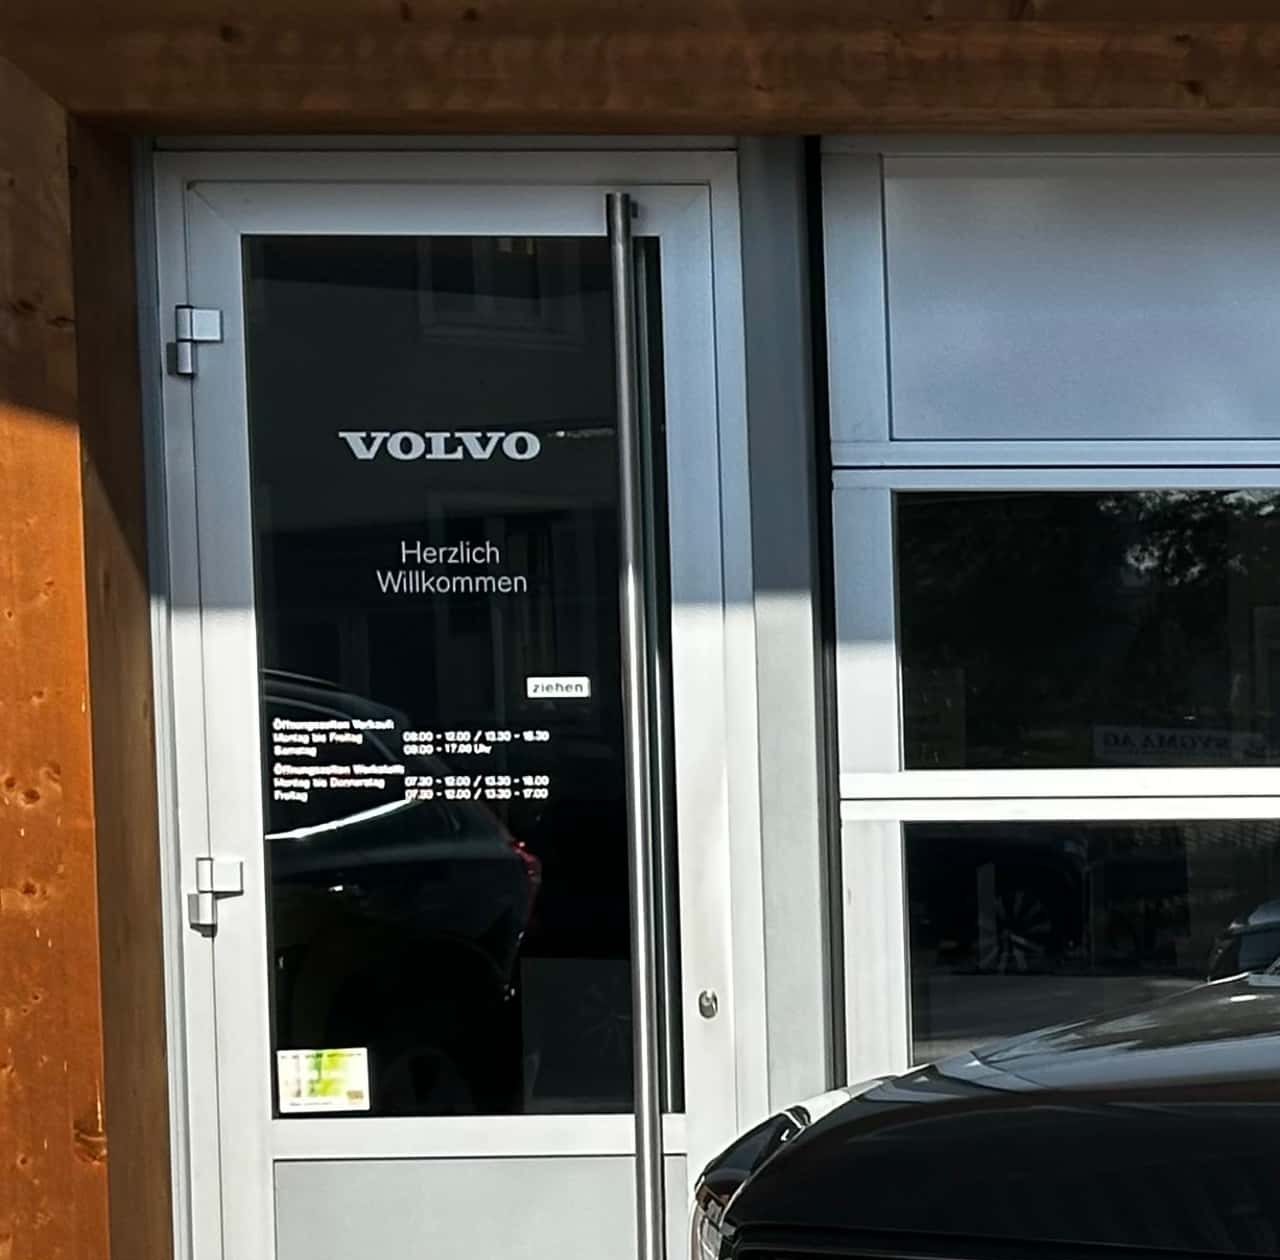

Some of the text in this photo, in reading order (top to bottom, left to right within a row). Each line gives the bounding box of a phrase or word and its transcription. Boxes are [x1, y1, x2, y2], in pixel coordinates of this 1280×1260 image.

[339, 432, 540, 459] VOLVO
[402, 541, 499, 563] Herzlich
[377, 571, 526, 592] Willkommen
[532, 682, 584, 693] ziehen
[273, 733, 309, 744] Montag
[312, 733, 326, 742] bis
[329, 732, 362, 744] Freitag
[274, 745, 317, 757] Samstag
[274, 778, 310, 789] Montag
[313, 779, 327, 787] bis
[274, 790, 308, 802] Freitag
